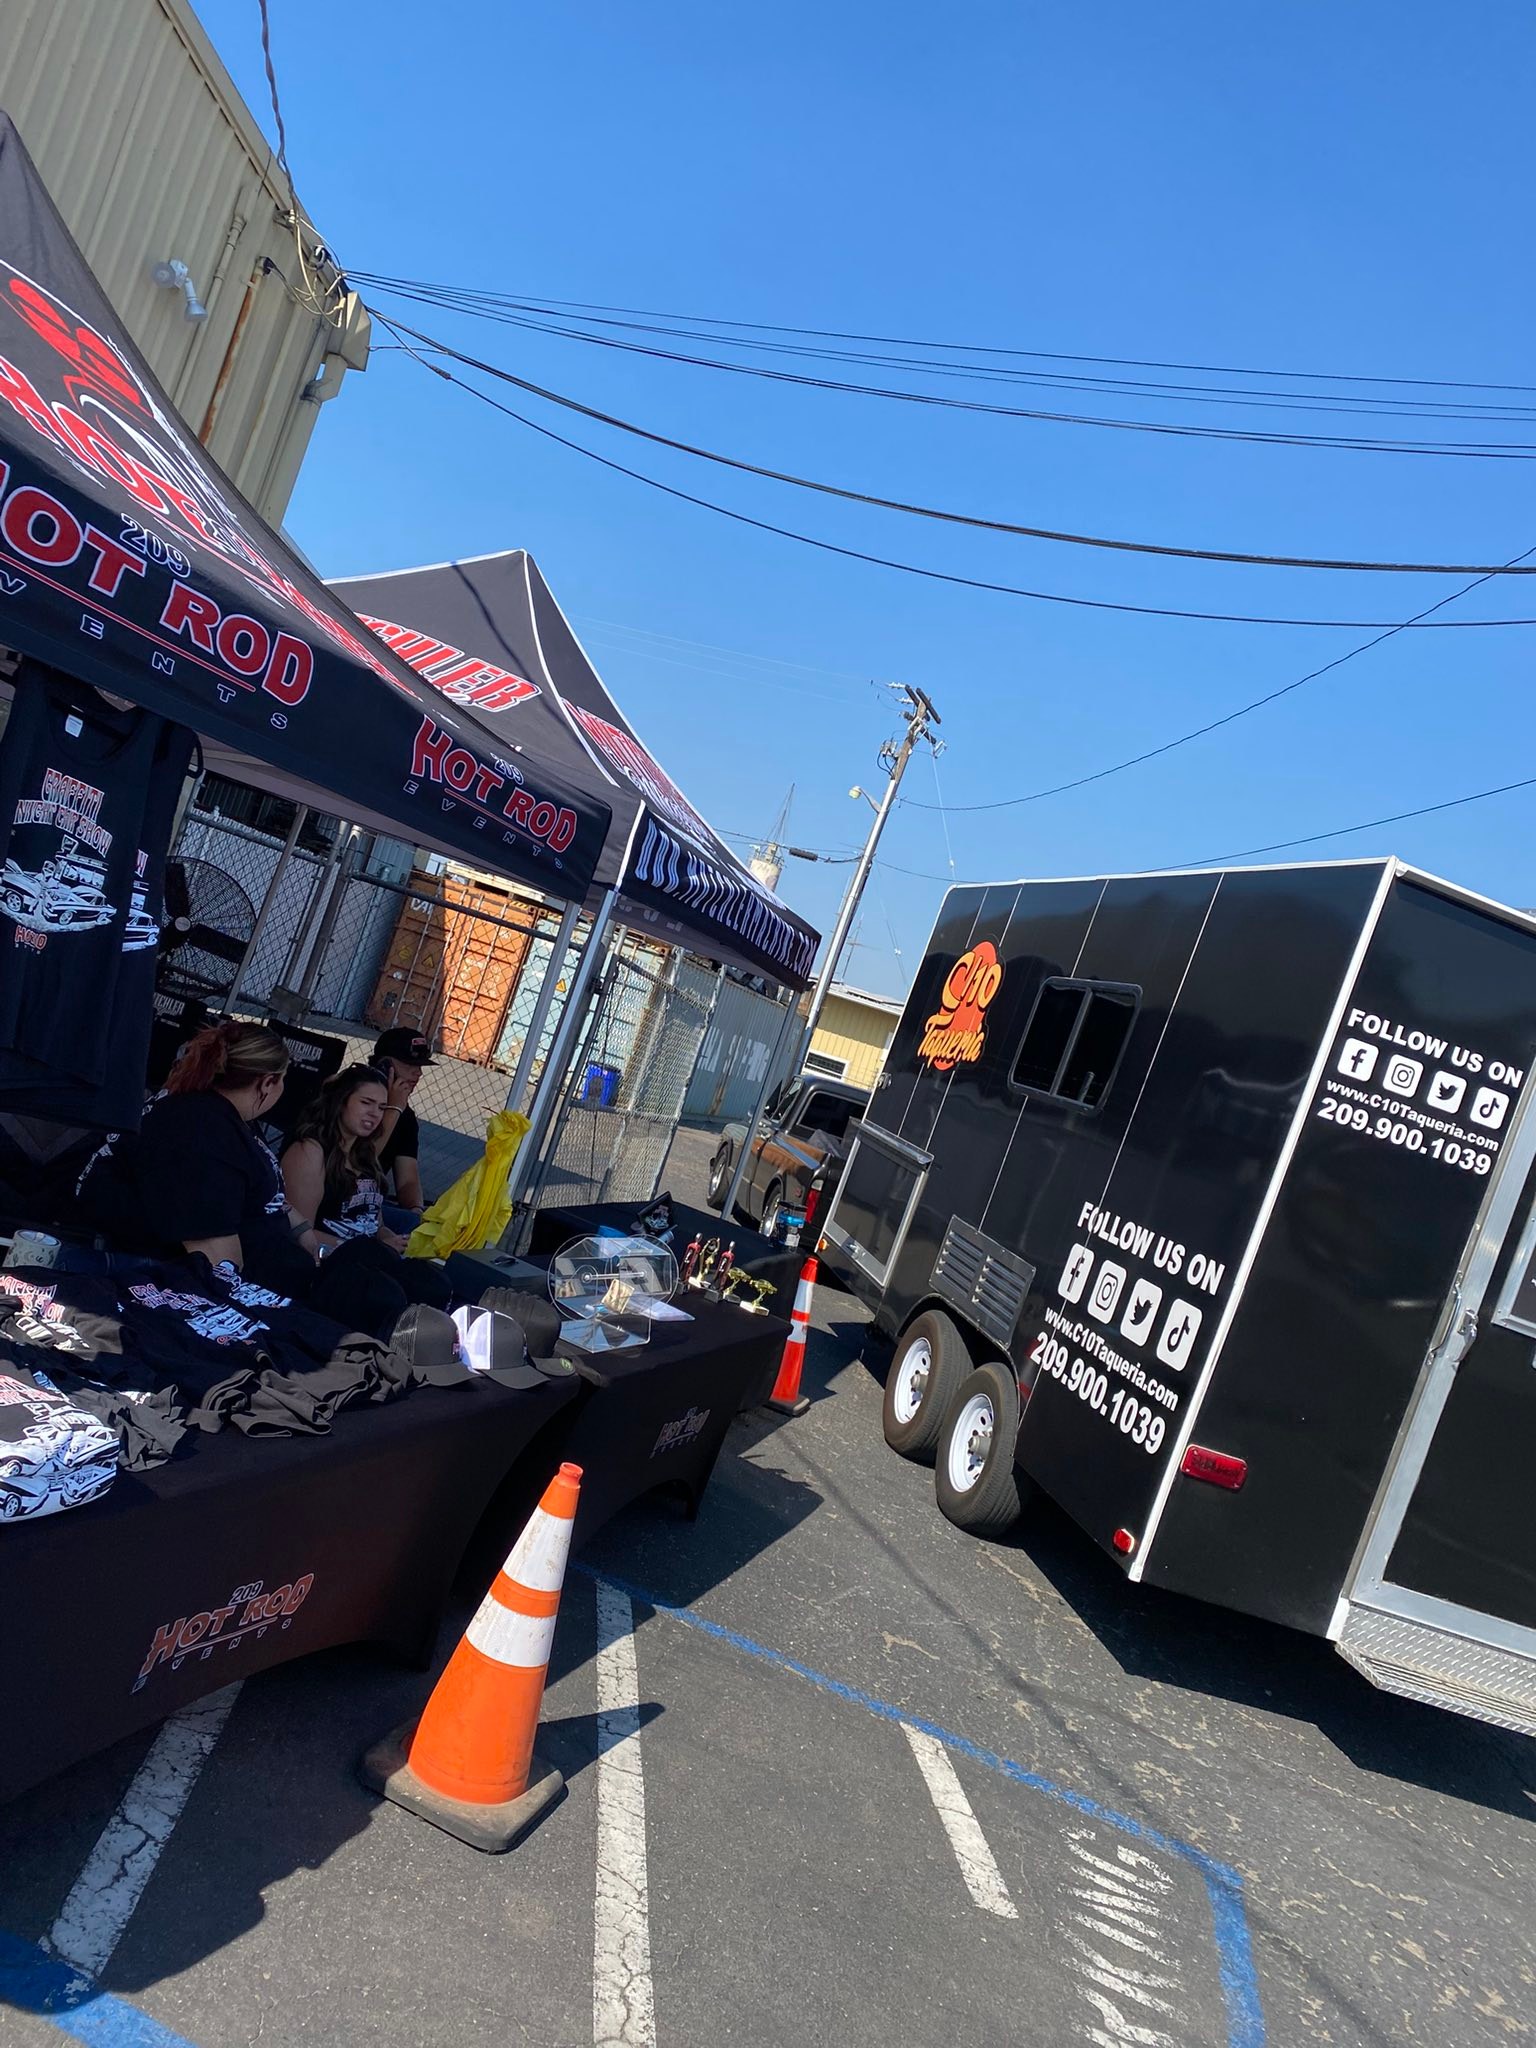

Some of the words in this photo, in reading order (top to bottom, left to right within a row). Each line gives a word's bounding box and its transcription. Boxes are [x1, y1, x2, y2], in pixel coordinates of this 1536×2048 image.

[0, 459, 147, 598] OT
[159, 579, 314, 706] ROD
[120, 513, 191, 578] 209
[410, 714, 504, 803] HOT
[503, 787, 578, 853] ROD
[54, 806, 82, 835] CAR
[75, 818, 113, 859] SHOW
[917, 1012, 985, 1069] Taqueria
[1347, 1008, 1449, 1059] FOLLOW
[1450, 1046, 1485, 1074] US
[1488, 1061, 1524, 1089] ON
[1316, 1096, 1493, 1176] 209.900.1039
[1326, 1080, 1500, 1152] www.C10Taqueria.com
[1076, 1201, 1156, 1260] FOLLOW
[1153, 1236, 1187, 1276] US
[1186, 1253, 1226, 1297] ON
[1029, 1331, 1167, 1455] 209.900.1039
[1044, 1306, 1180, 1412] www.C10Taqueria.com
[138, 1605, 236, 1679] HOT
[238, 1572, 315, 1627] ROD
